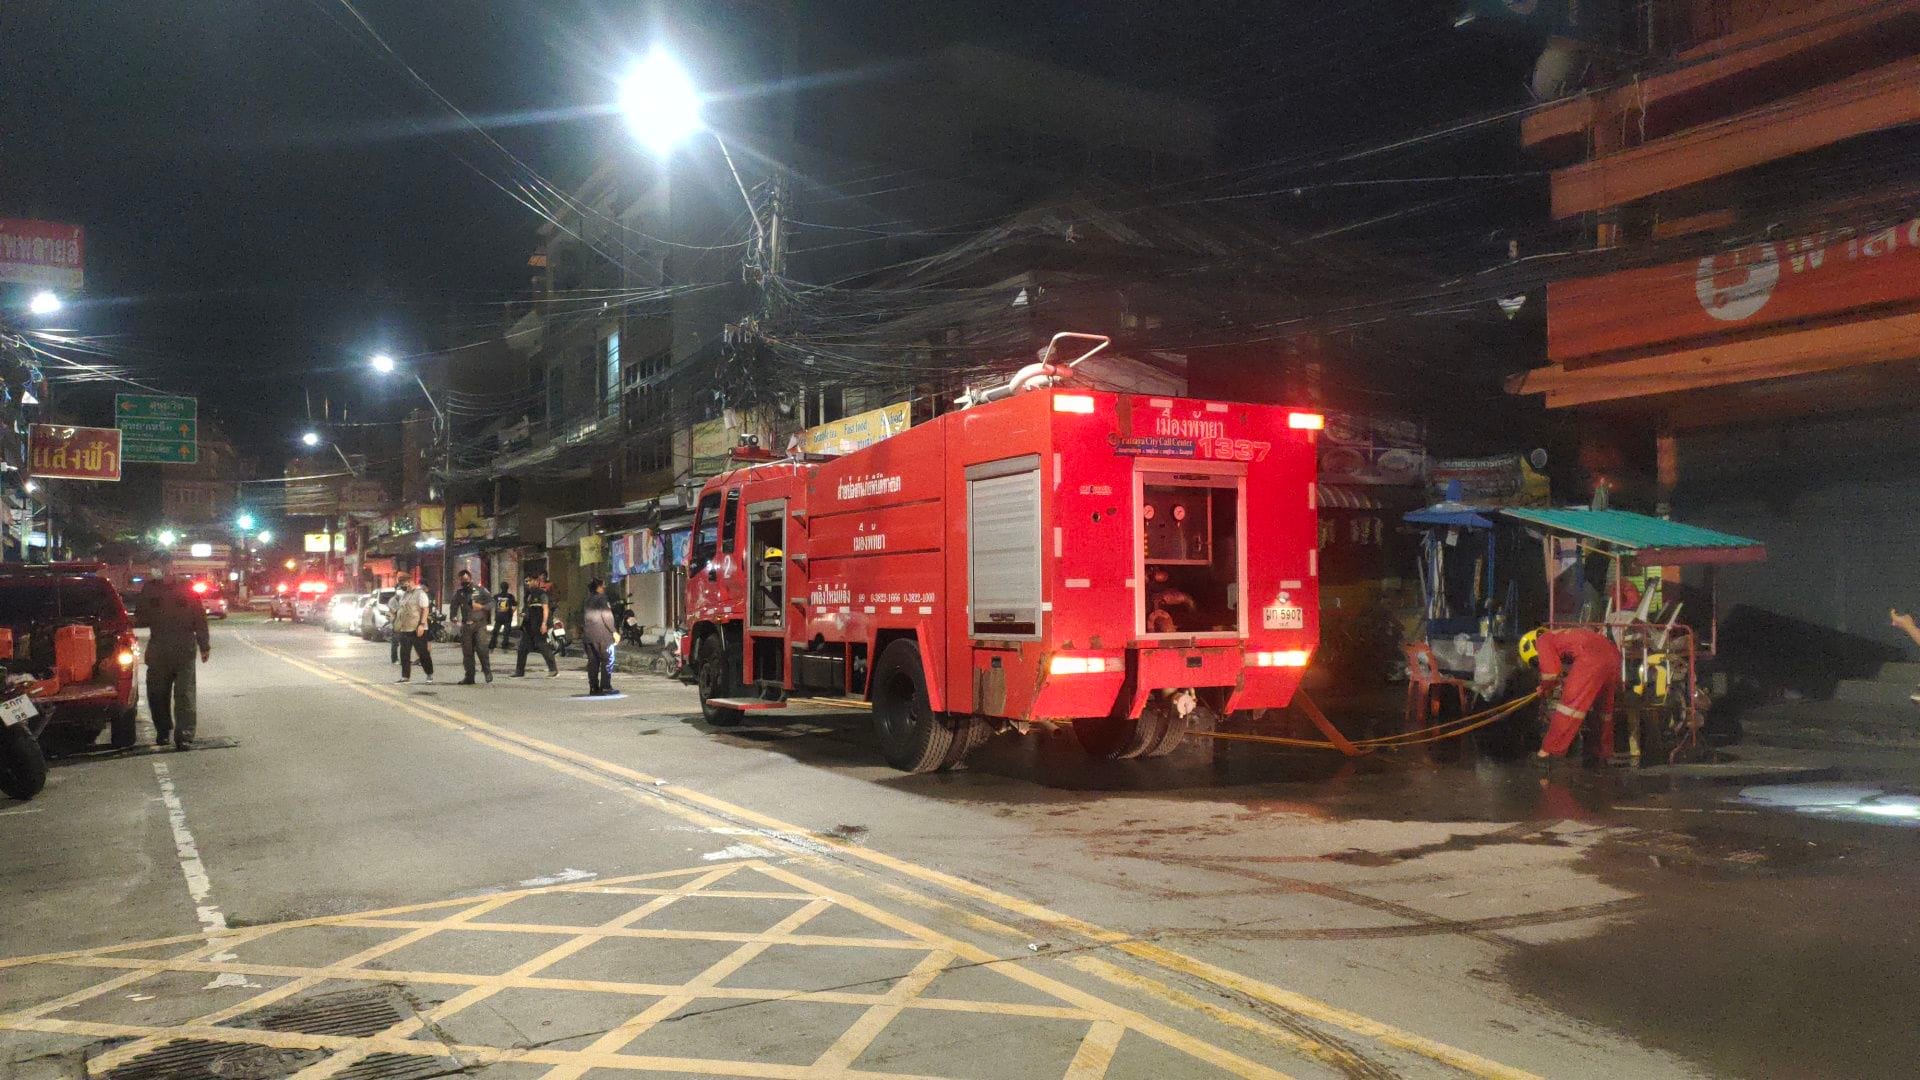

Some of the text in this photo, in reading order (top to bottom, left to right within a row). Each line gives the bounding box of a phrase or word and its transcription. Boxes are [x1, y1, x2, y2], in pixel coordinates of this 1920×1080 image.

[1156, 408, 1224, 439] เมืองพัทยา
[1146, 437, 1158, 447] City
[1160, 437, 1171, 447] Call
[1172, 437, 1193, 447] Center
[1199, 437, 1272, 463] 1337
[853, 522, 886, 552] เมืองพัทยา
[724, 554, 731, 578] 2
